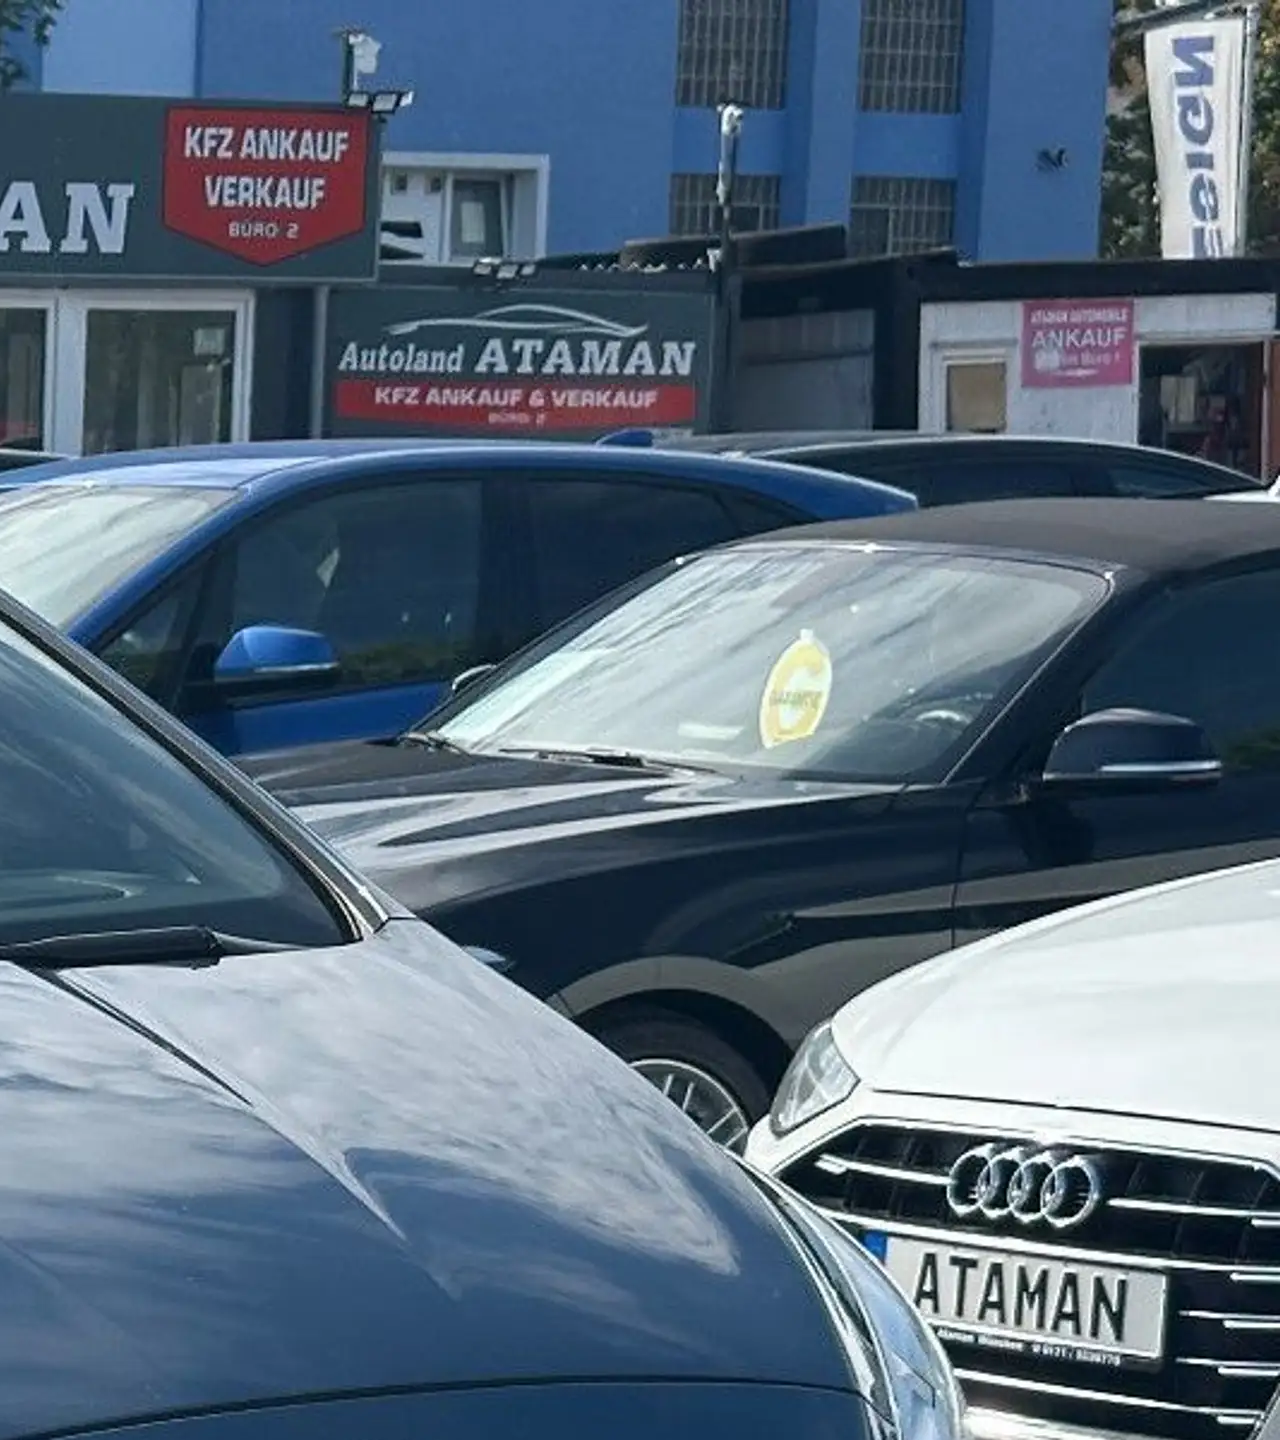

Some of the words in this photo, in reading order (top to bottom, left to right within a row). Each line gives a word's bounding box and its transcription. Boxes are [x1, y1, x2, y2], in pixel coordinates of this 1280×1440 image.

[184, 126, 234, 159] KFZ
[240, 128, 350, 163] ANKAUF
[204, 175, 327, 210] VERKAUF
[286, 222, 299, 239] 2
[1032, 325, 1128, 348] ANKAUF
[338, 341, 465, 374] Autoland
[474, 337, 696, 376] ATAMAN
[375, 386, 419, 405] KFZ
[425, 387, 522, 407] ANKAUF
[527, 388, 545, 408] &
[550, 389, 659, 409] VERKAUF
[914, 1252, 1129, 1343] ATAMAN
